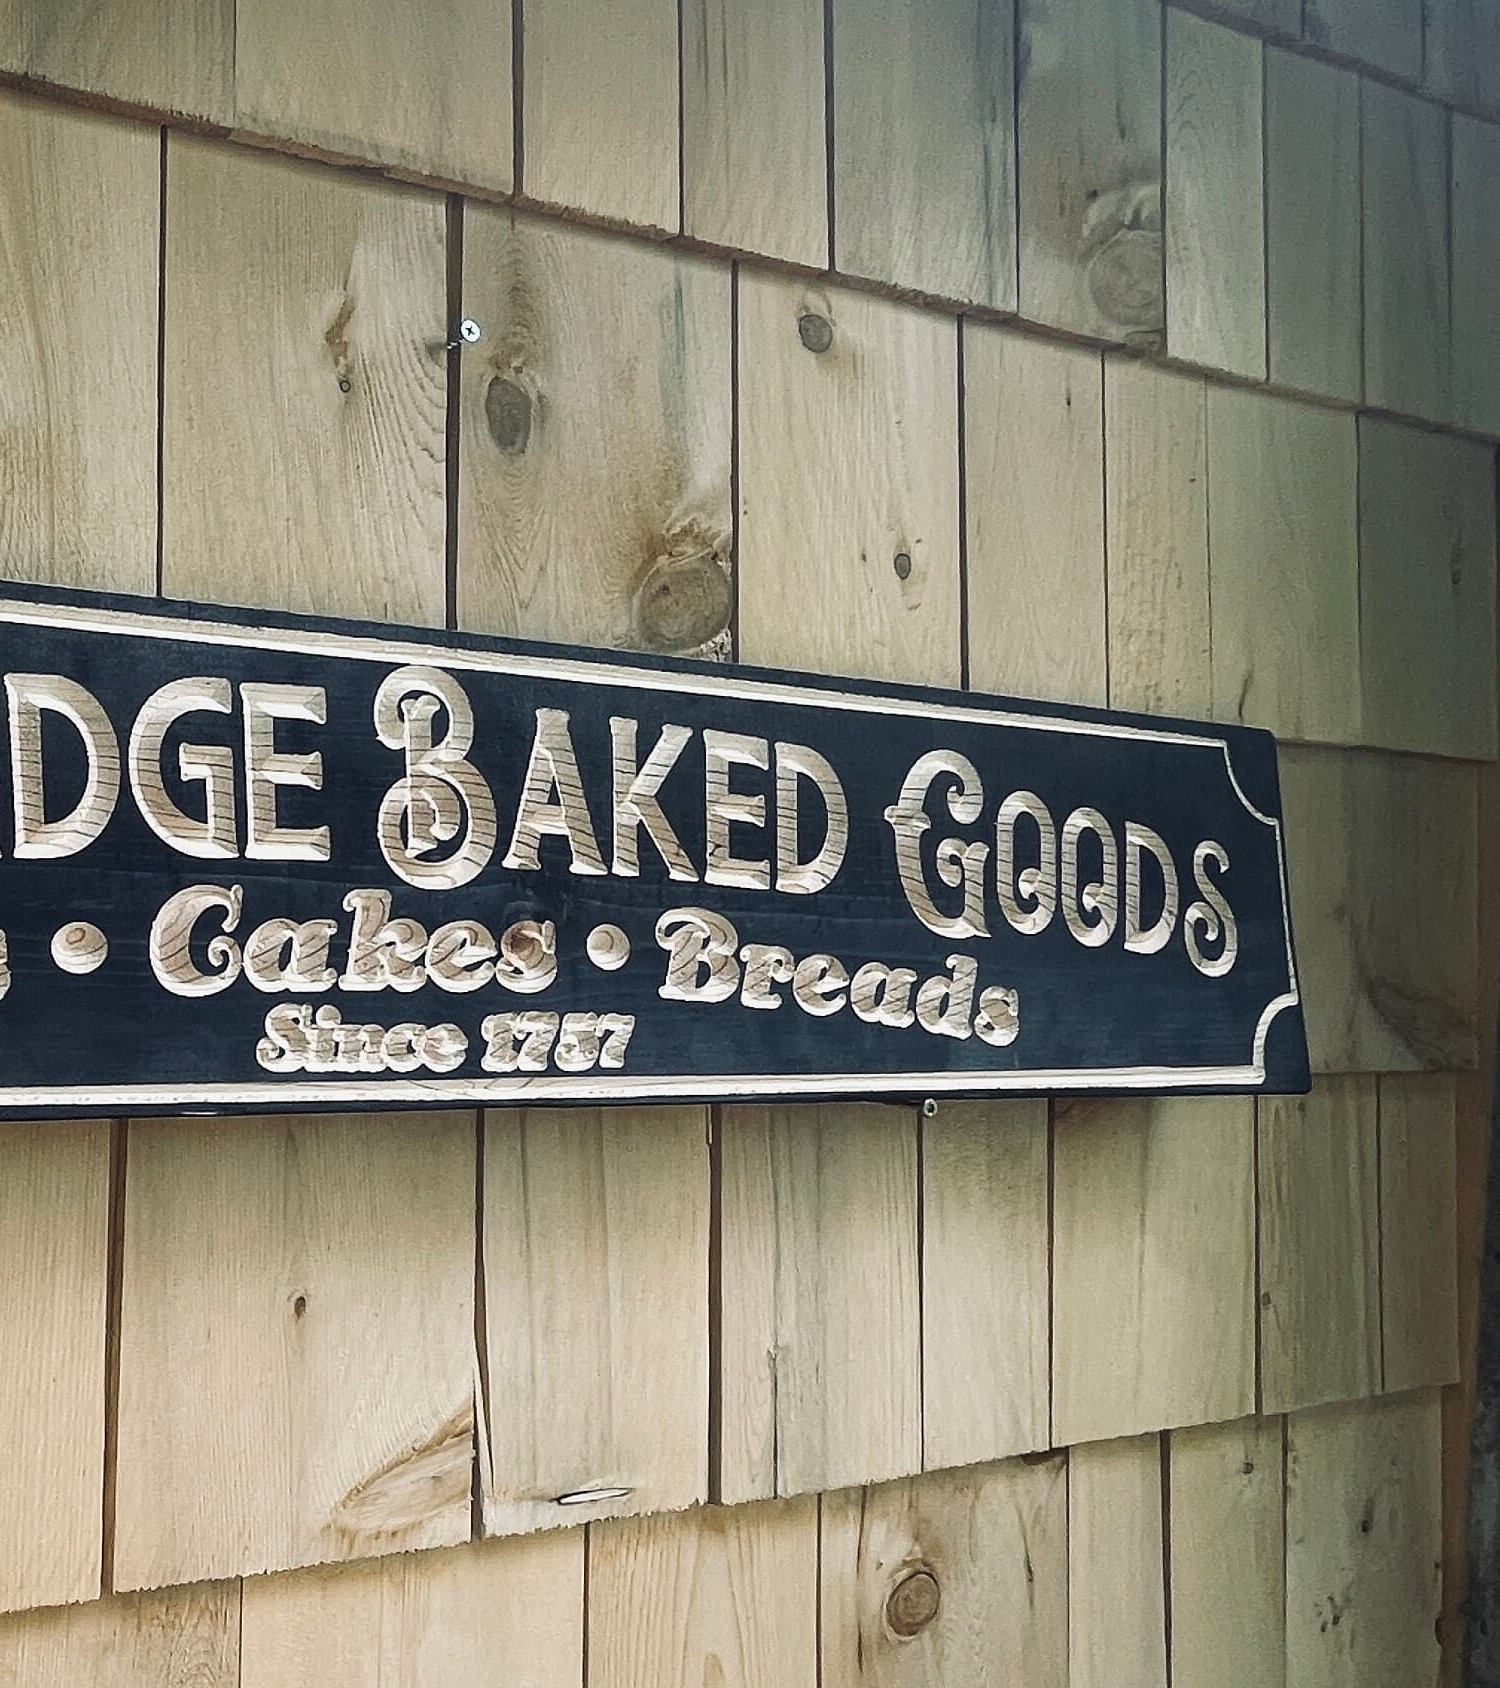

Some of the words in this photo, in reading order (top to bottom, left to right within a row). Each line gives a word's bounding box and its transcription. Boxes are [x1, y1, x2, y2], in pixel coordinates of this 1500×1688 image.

[373, 665, 849, 895] BAKED
[884, 749, 1238, 978] GOODS
[149, 884, 558, 998] Cakes
[655, 907, 1020, 1046] Breads
[256, 1003, 469, 1073] Since
[481, 1011, 636, 1072] 1757
